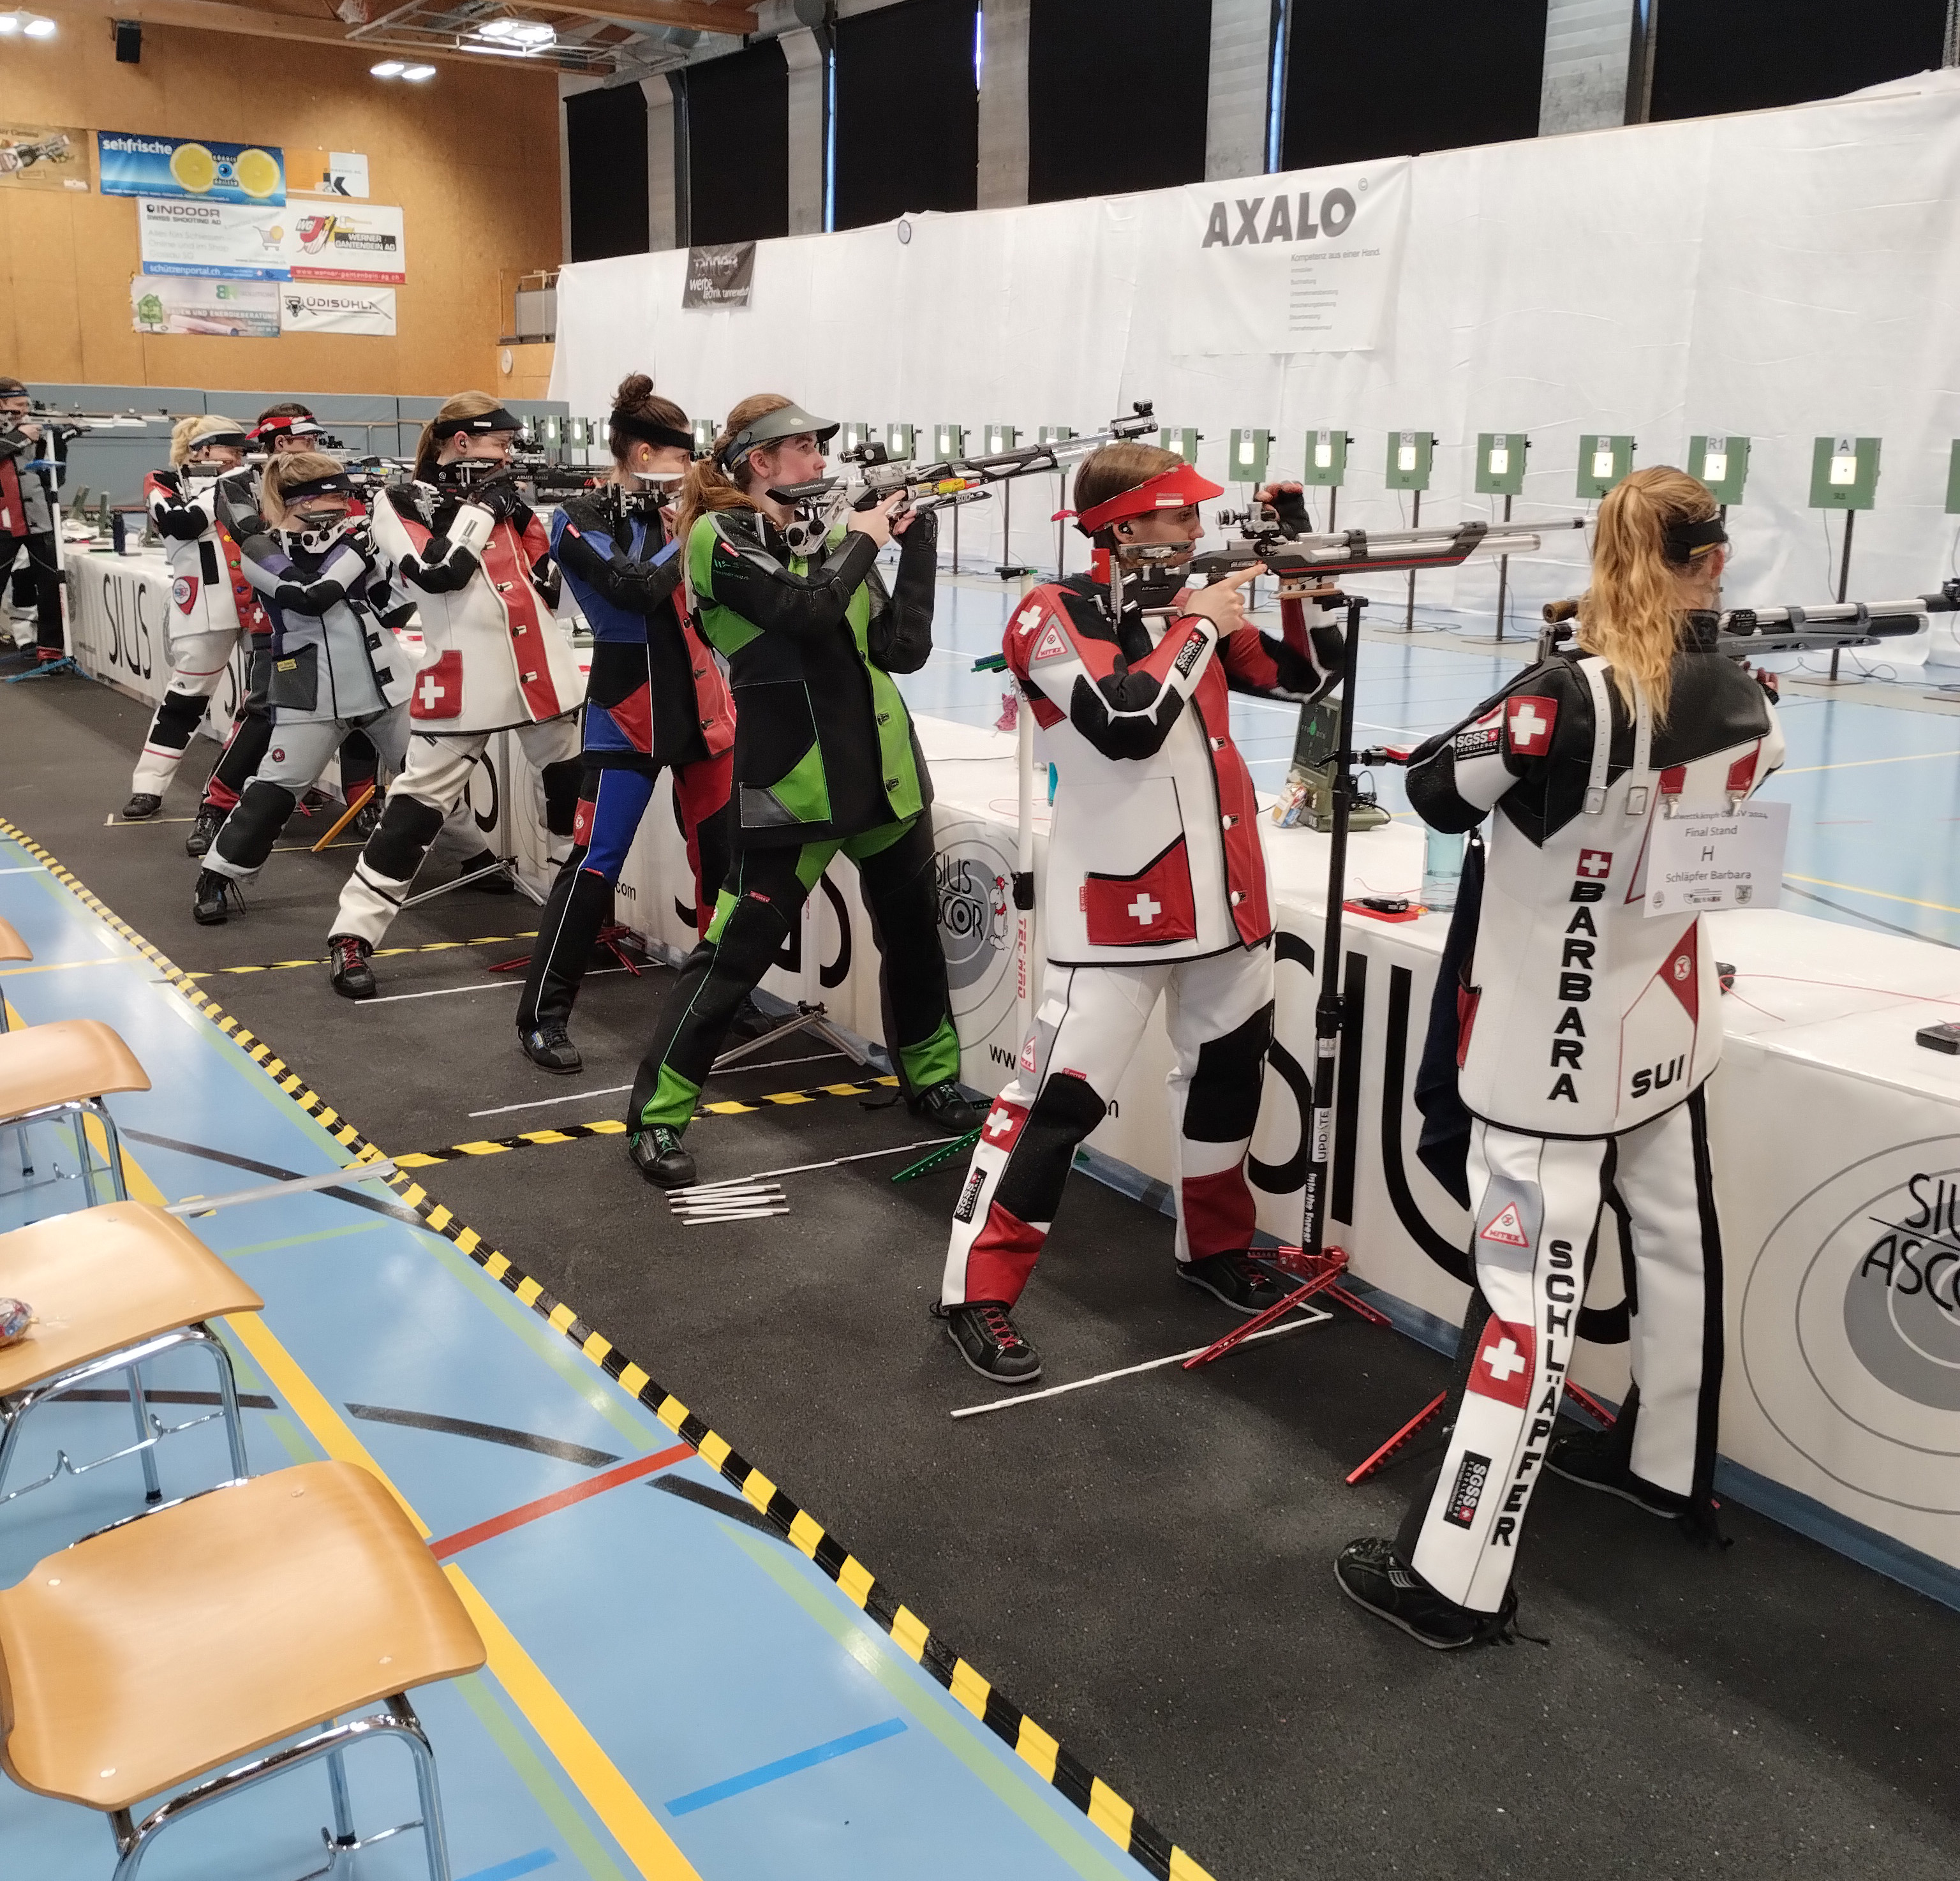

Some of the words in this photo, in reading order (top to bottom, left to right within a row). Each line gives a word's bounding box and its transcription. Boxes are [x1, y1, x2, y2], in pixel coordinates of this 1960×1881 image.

[102, 138, 173, 154] sehfrische
[156, 205, 220, 218] INDOOR
[1201, 187, 1356, 248] AXALO
[348, 234, 382, 242] WERNER
[336, 240, 383, 250] GANTENBEIN
[1291, 253, 1326, 262] Kompetenz
[1342, 250, 1360, 258] einer
[150, 264, 221, 276] schützenportal.ch
[1173, 429, 1179, 438] F
[1244, 430, 1250, 439] G
[1320, 432, 1326, 441] H
[1402, 433, 1414, 443] R2
[1708, 438, 1725, 449] R1
[1839, 440, 1850, 451] A
[956, 494, 971, 503] 800
[104, 573, 152, 680] SIUS
[1177, 640, 1196, 668] SGSS
[1457, 731, 1489, 748] SGSS
[1685, 826, 1709, 836] Final
[1711, 825, 1737, 835] Stand
[1701, 845, 1715, 861] H
[1665, 872, 1709, 883] Schläpfer
[1711, 870, 1751, 880] Barbara
[1547, 881, 1605, 1104] BARBARA
[1630, 1054, 1686, 1098] SUI
[957, 1182, 974, 1216] SGSS
[1491, 1240, 1574, 1547] SCHLÄPFER
[1463, 1464, 1487, 1508] SGSS
